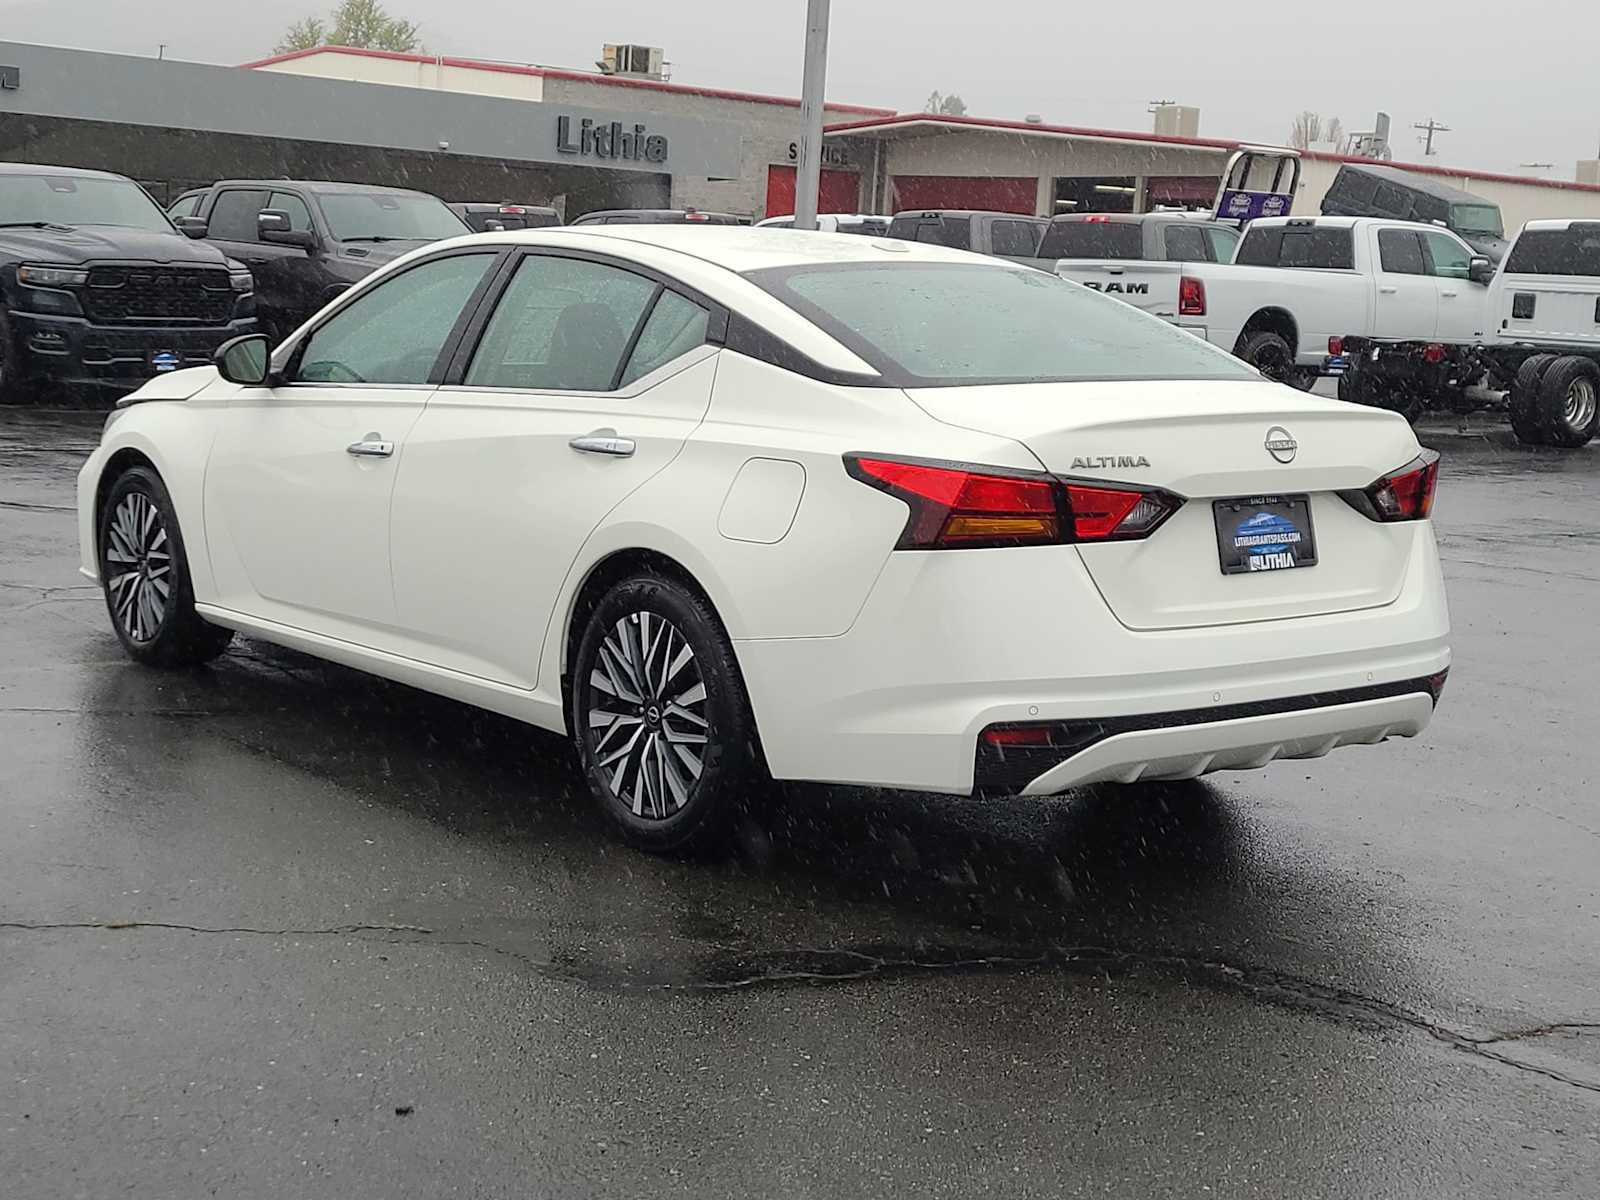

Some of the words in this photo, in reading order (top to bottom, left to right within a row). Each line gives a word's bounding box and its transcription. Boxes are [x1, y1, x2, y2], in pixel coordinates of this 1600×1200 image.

[557, 115, 668, 162] Lithia
[1070, 455, 1151, 469] ALTIMA
[1261, 552, 1295, 570] LITHIA
